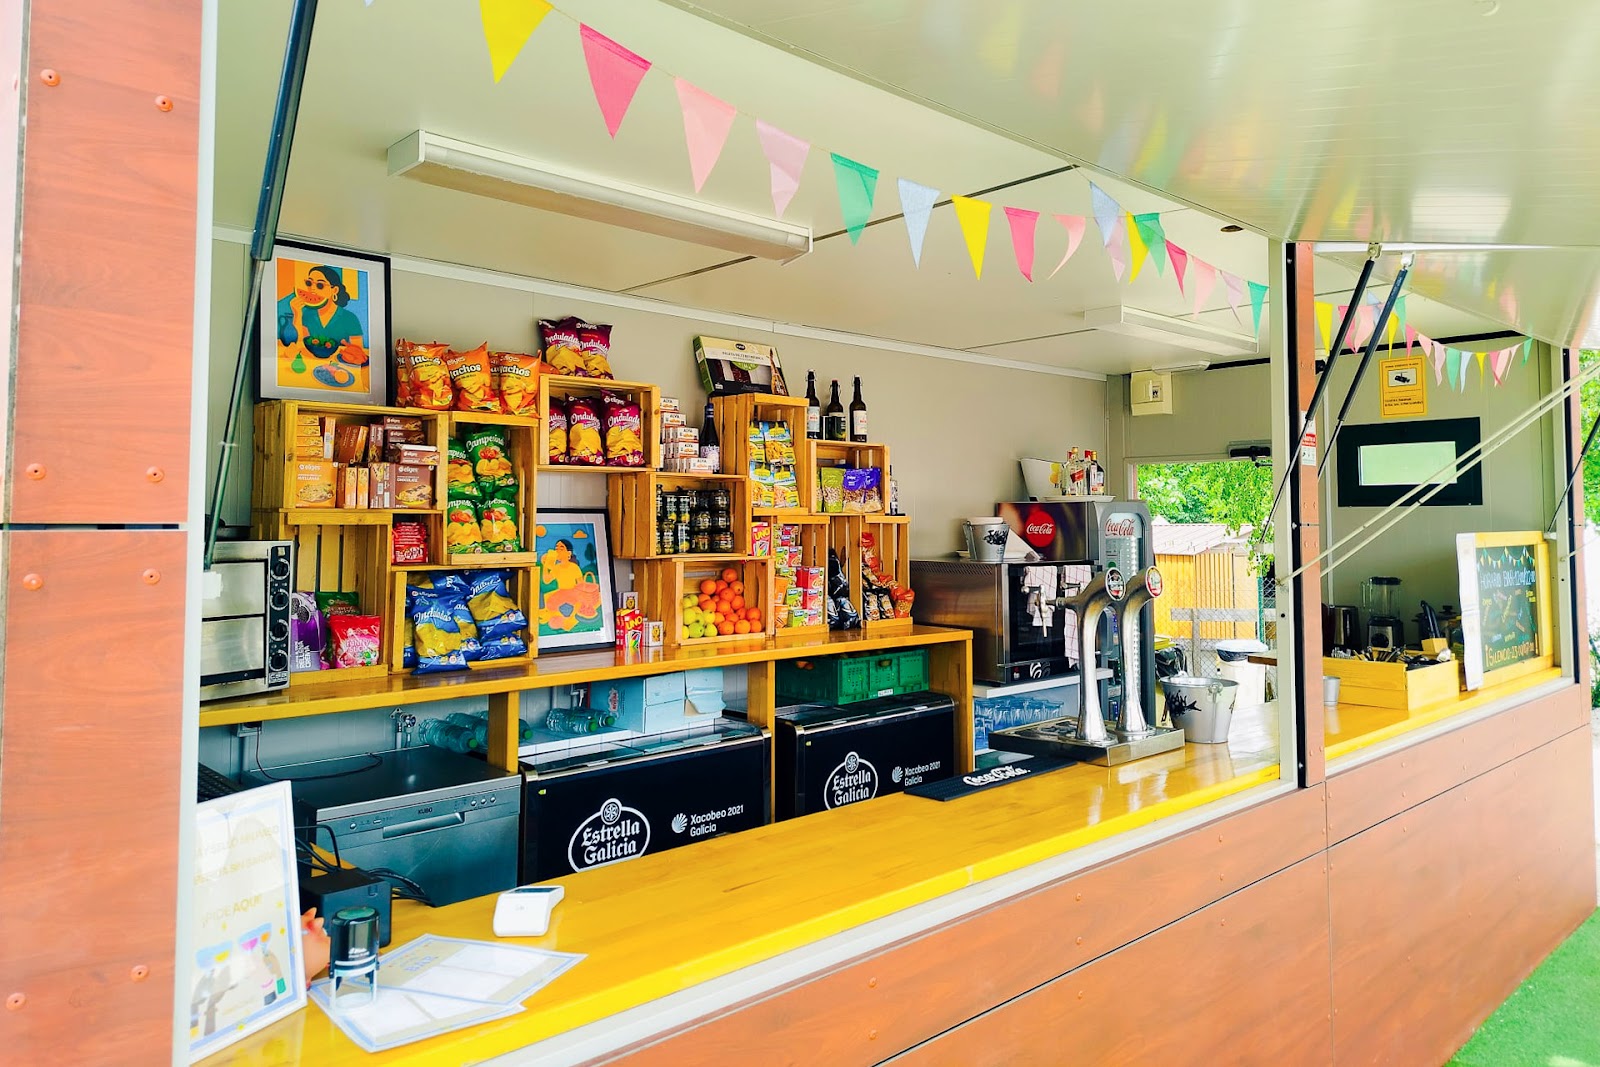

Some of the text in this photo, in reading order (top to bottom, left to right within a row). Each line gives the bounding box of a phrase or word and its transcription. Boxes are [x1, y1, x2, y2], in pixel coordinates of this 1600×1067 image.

[754, 528, 770, 540] UNO
[626, 616, 643, 631] UNO
[904, 760, 941, 776] Xacobeo 2021
[832, 769, 871, 791] Estrella
[904, 775, 923, 786] Galicia
[834, 786, 870, 806] Galicia
[690, 805, 744, 826] Xacobeo 2021
[581, 819, 640, 847] Estrella
[690, 822, 717, 837] Galicia
[584, 838, 636, 864] Galicia
